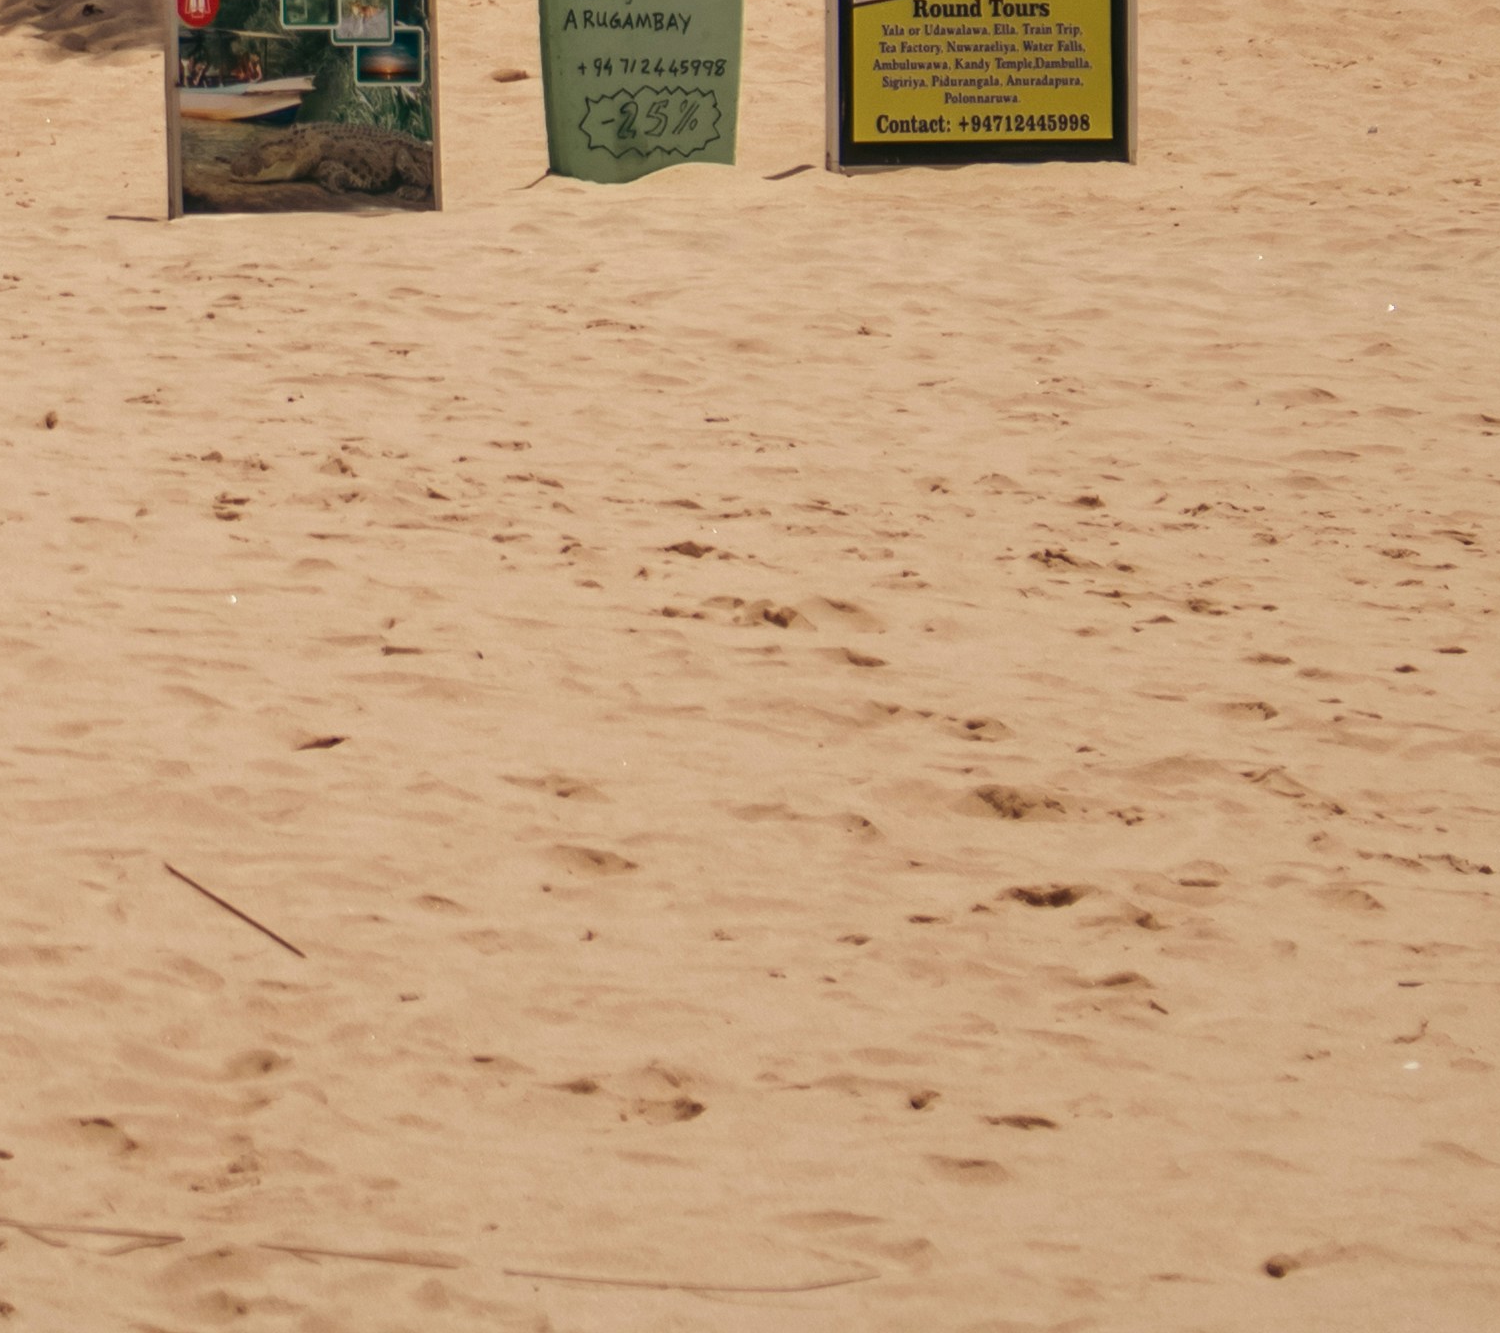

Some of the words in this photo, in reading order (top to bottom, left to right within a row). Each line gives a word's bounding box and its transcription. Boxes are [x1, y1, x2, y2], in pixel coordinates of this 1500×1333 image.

[563, 9, 691, 34] ARUGAMBAY
[876, 114, 950, 133] Contact:
[959, 114, 1090, 132] +94712445998
